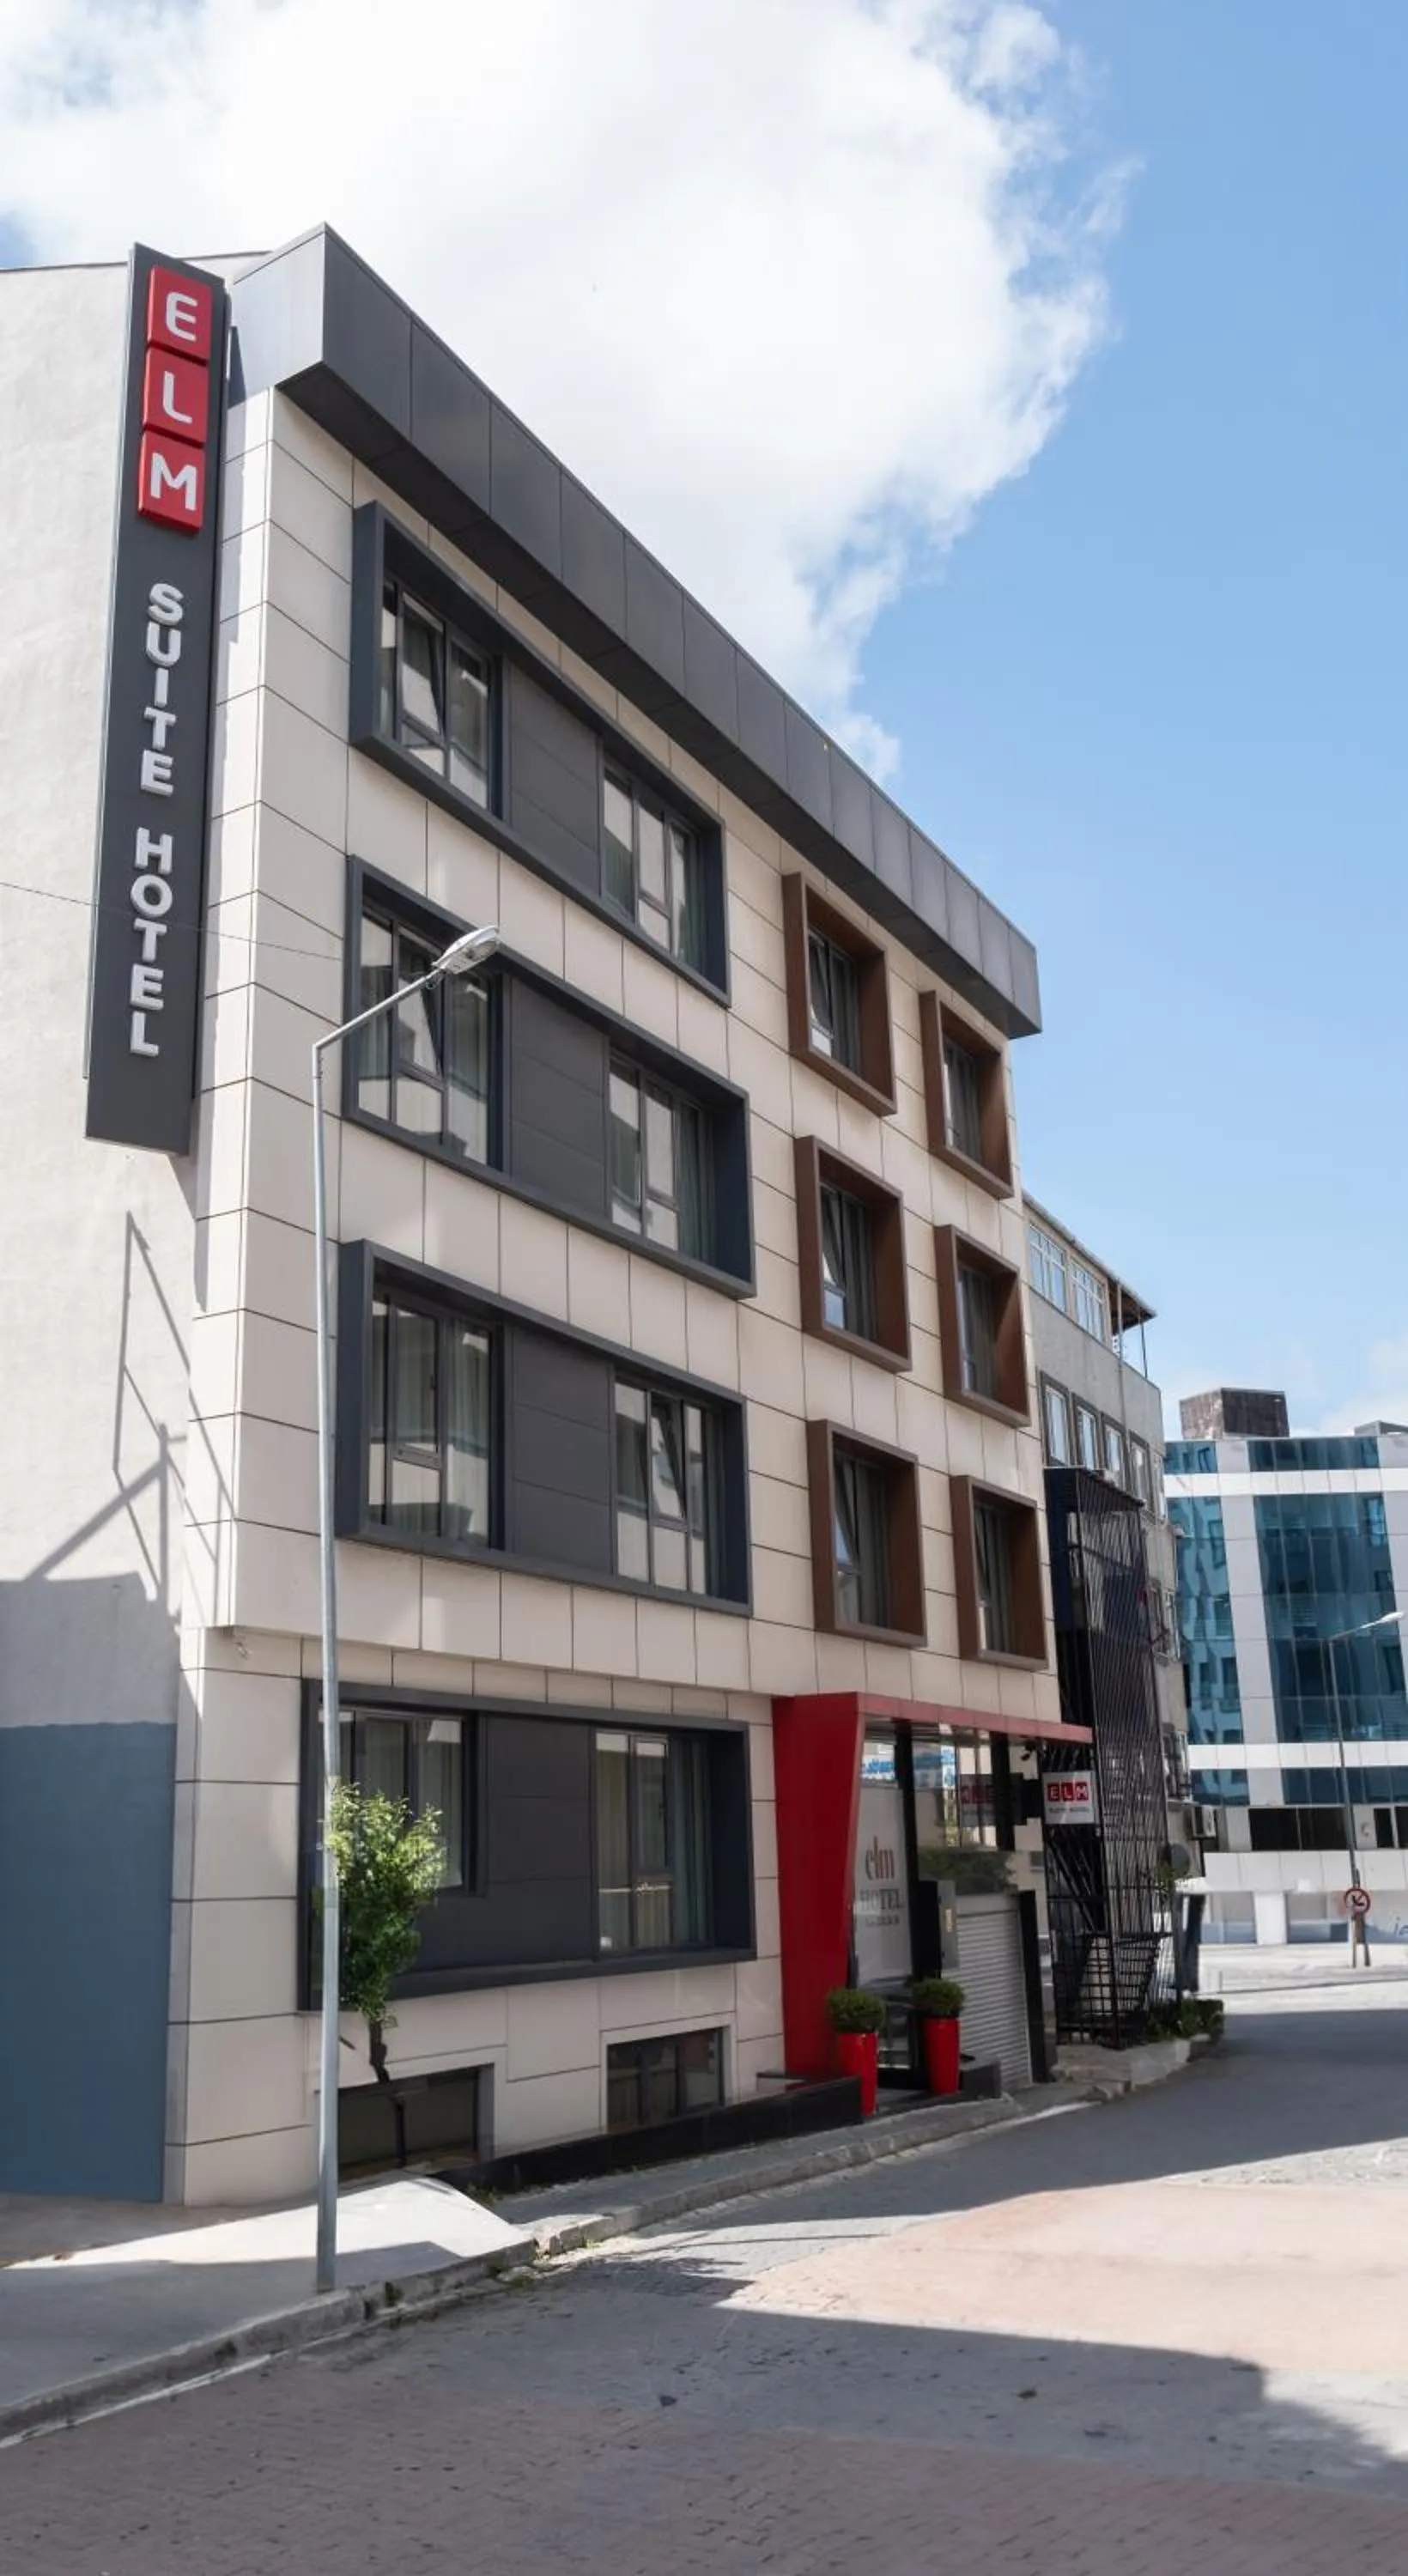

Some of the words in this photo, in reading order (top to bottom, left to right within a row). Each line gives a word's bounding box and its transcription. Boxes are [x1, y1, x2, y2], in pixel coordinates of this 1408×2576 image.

[149, 291, 199, 512] ELM
[140, 582, 185, 797] SUITE
[130, 826, 173, 1058] HOTEL
[1049, 1783, 1089, 1801] ELM
